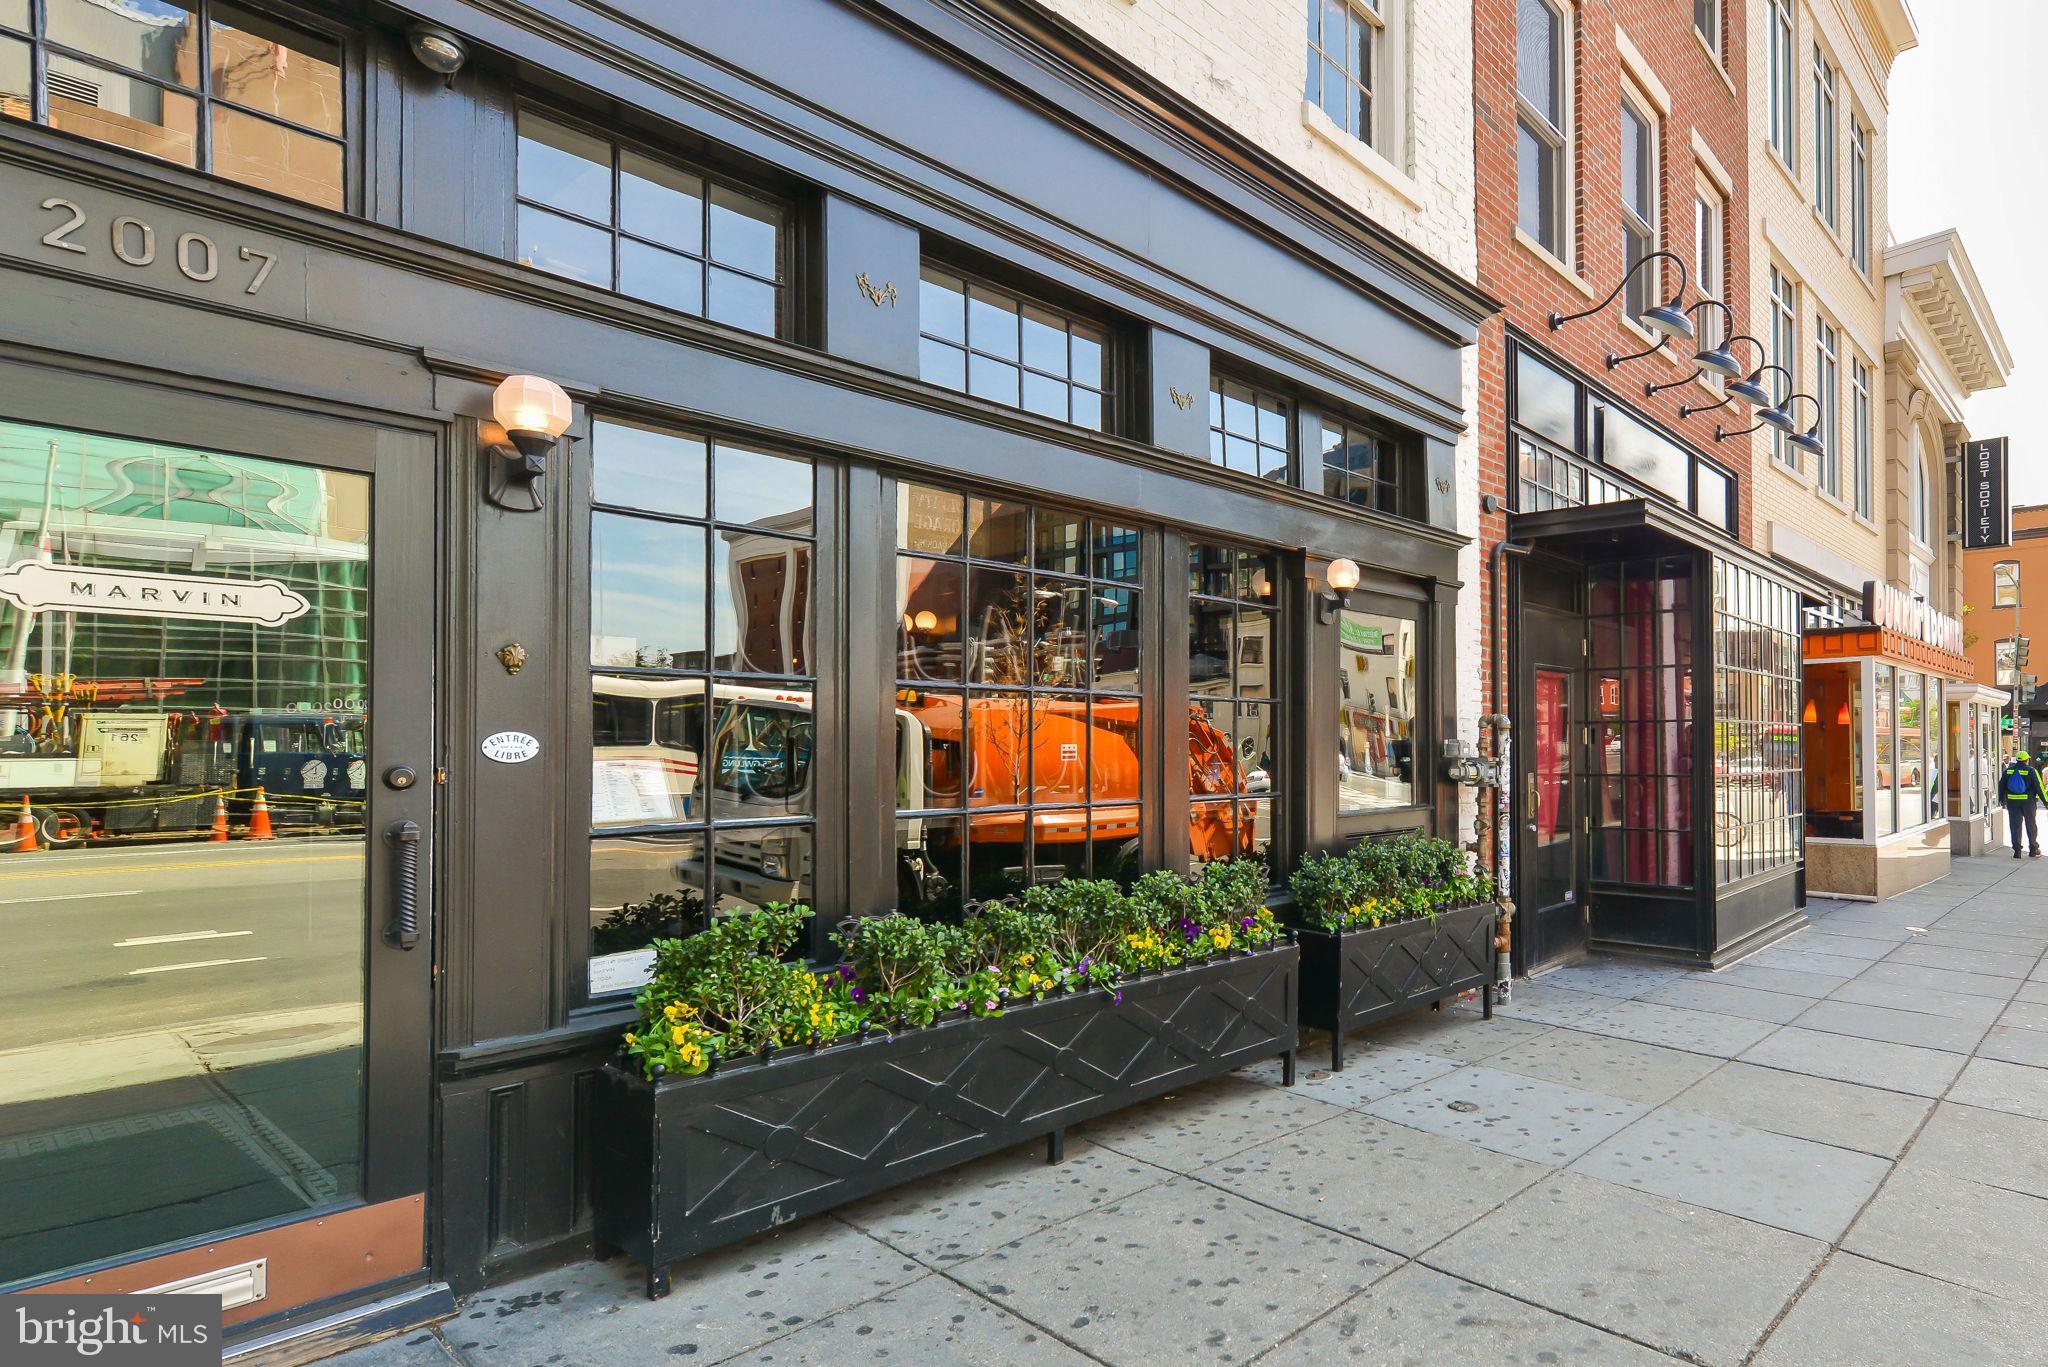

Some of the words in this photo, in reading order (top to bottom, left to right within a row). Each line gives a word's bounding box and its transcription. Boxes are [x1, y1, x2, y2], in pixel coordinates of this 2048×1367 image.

[41, 198, 277, 294] 2007
[1979, 443, 1990, 478] LOST
[1979, 481, 1990, 543] SOCIETY
[70, 581, 242, 607] MARVIN
[490, 734, 534, 747] ENTRÉE
[494, 749, 529, 760] LIBRE
